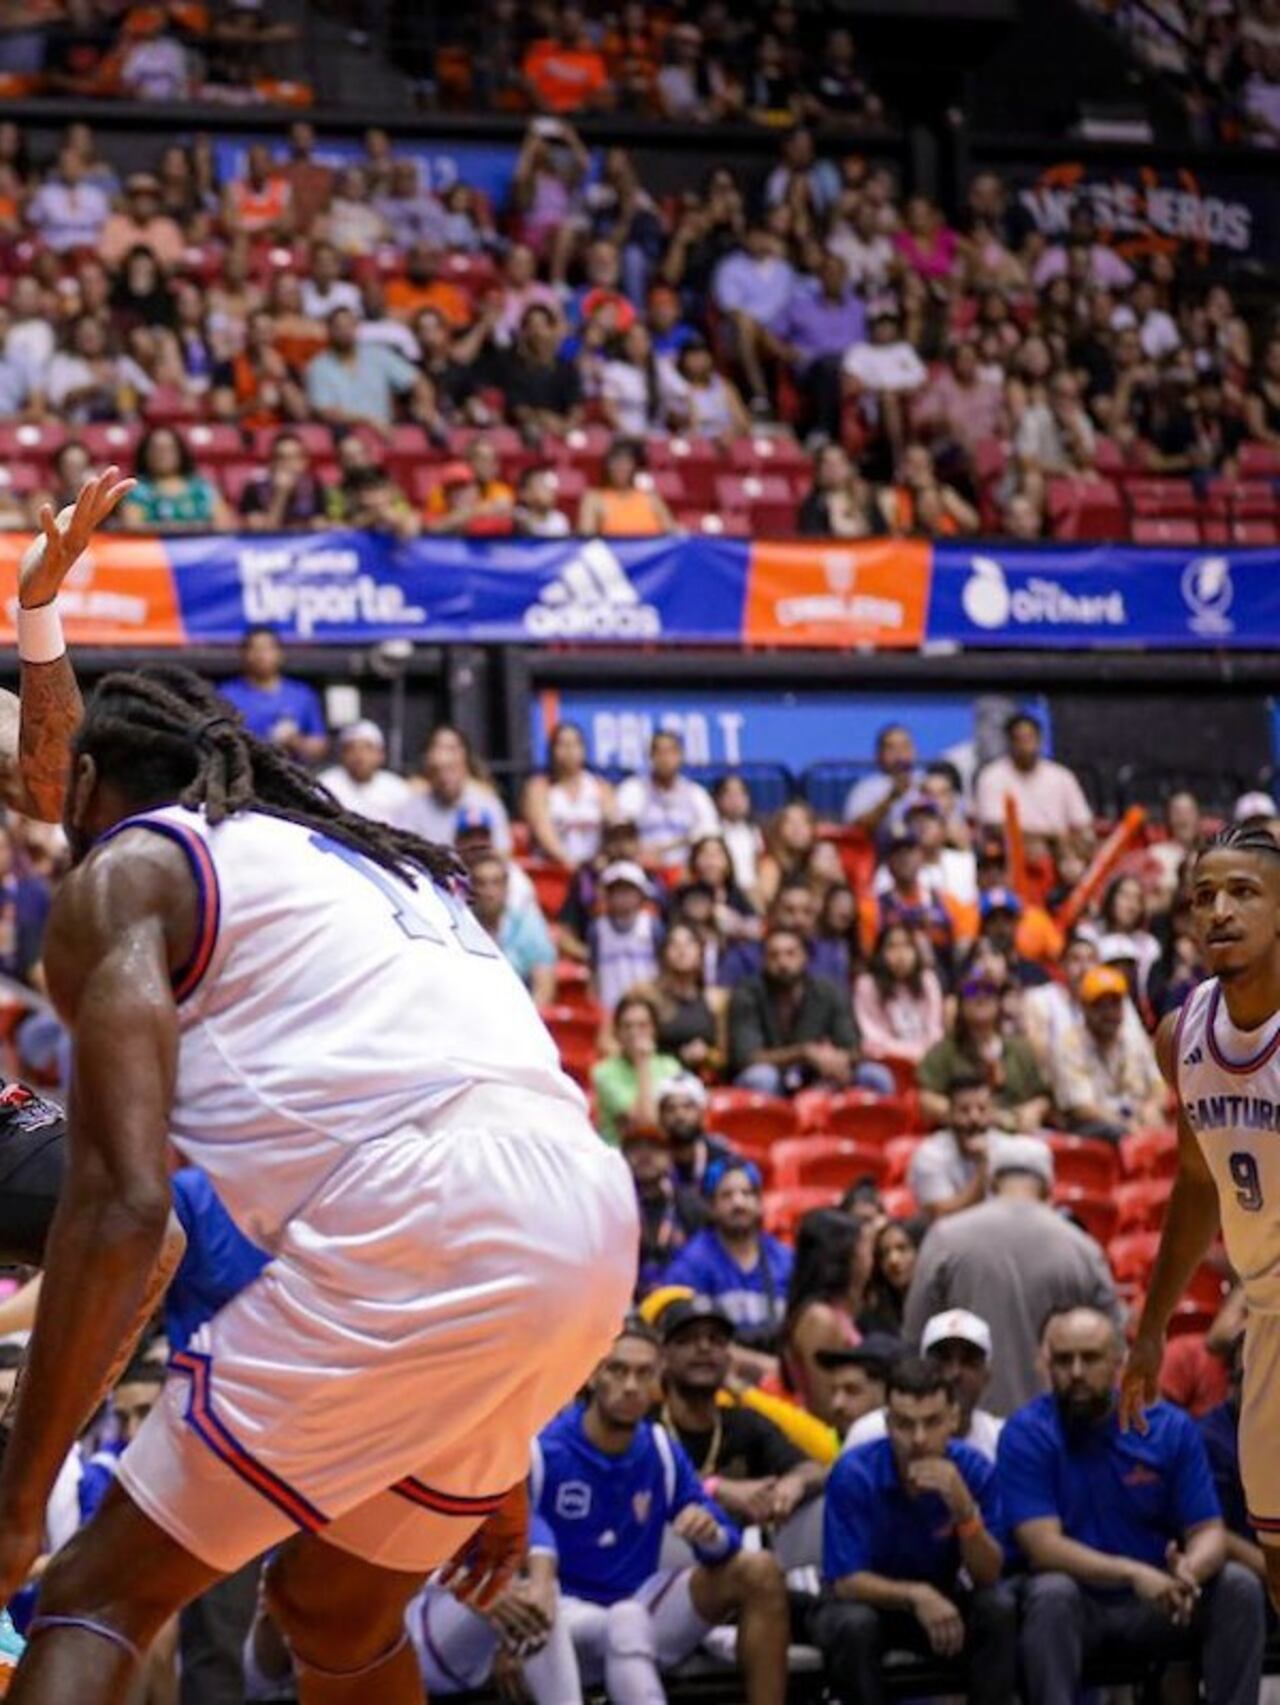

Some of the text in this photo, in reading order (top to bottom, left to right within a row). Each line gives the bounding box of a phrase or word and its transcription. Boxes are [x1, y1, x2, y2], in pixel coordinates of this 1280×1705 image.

[523, 601, 663, 639] adidas
[716, 711, 746, 768] T
[1228, 1151, 1264, 1213] 9
